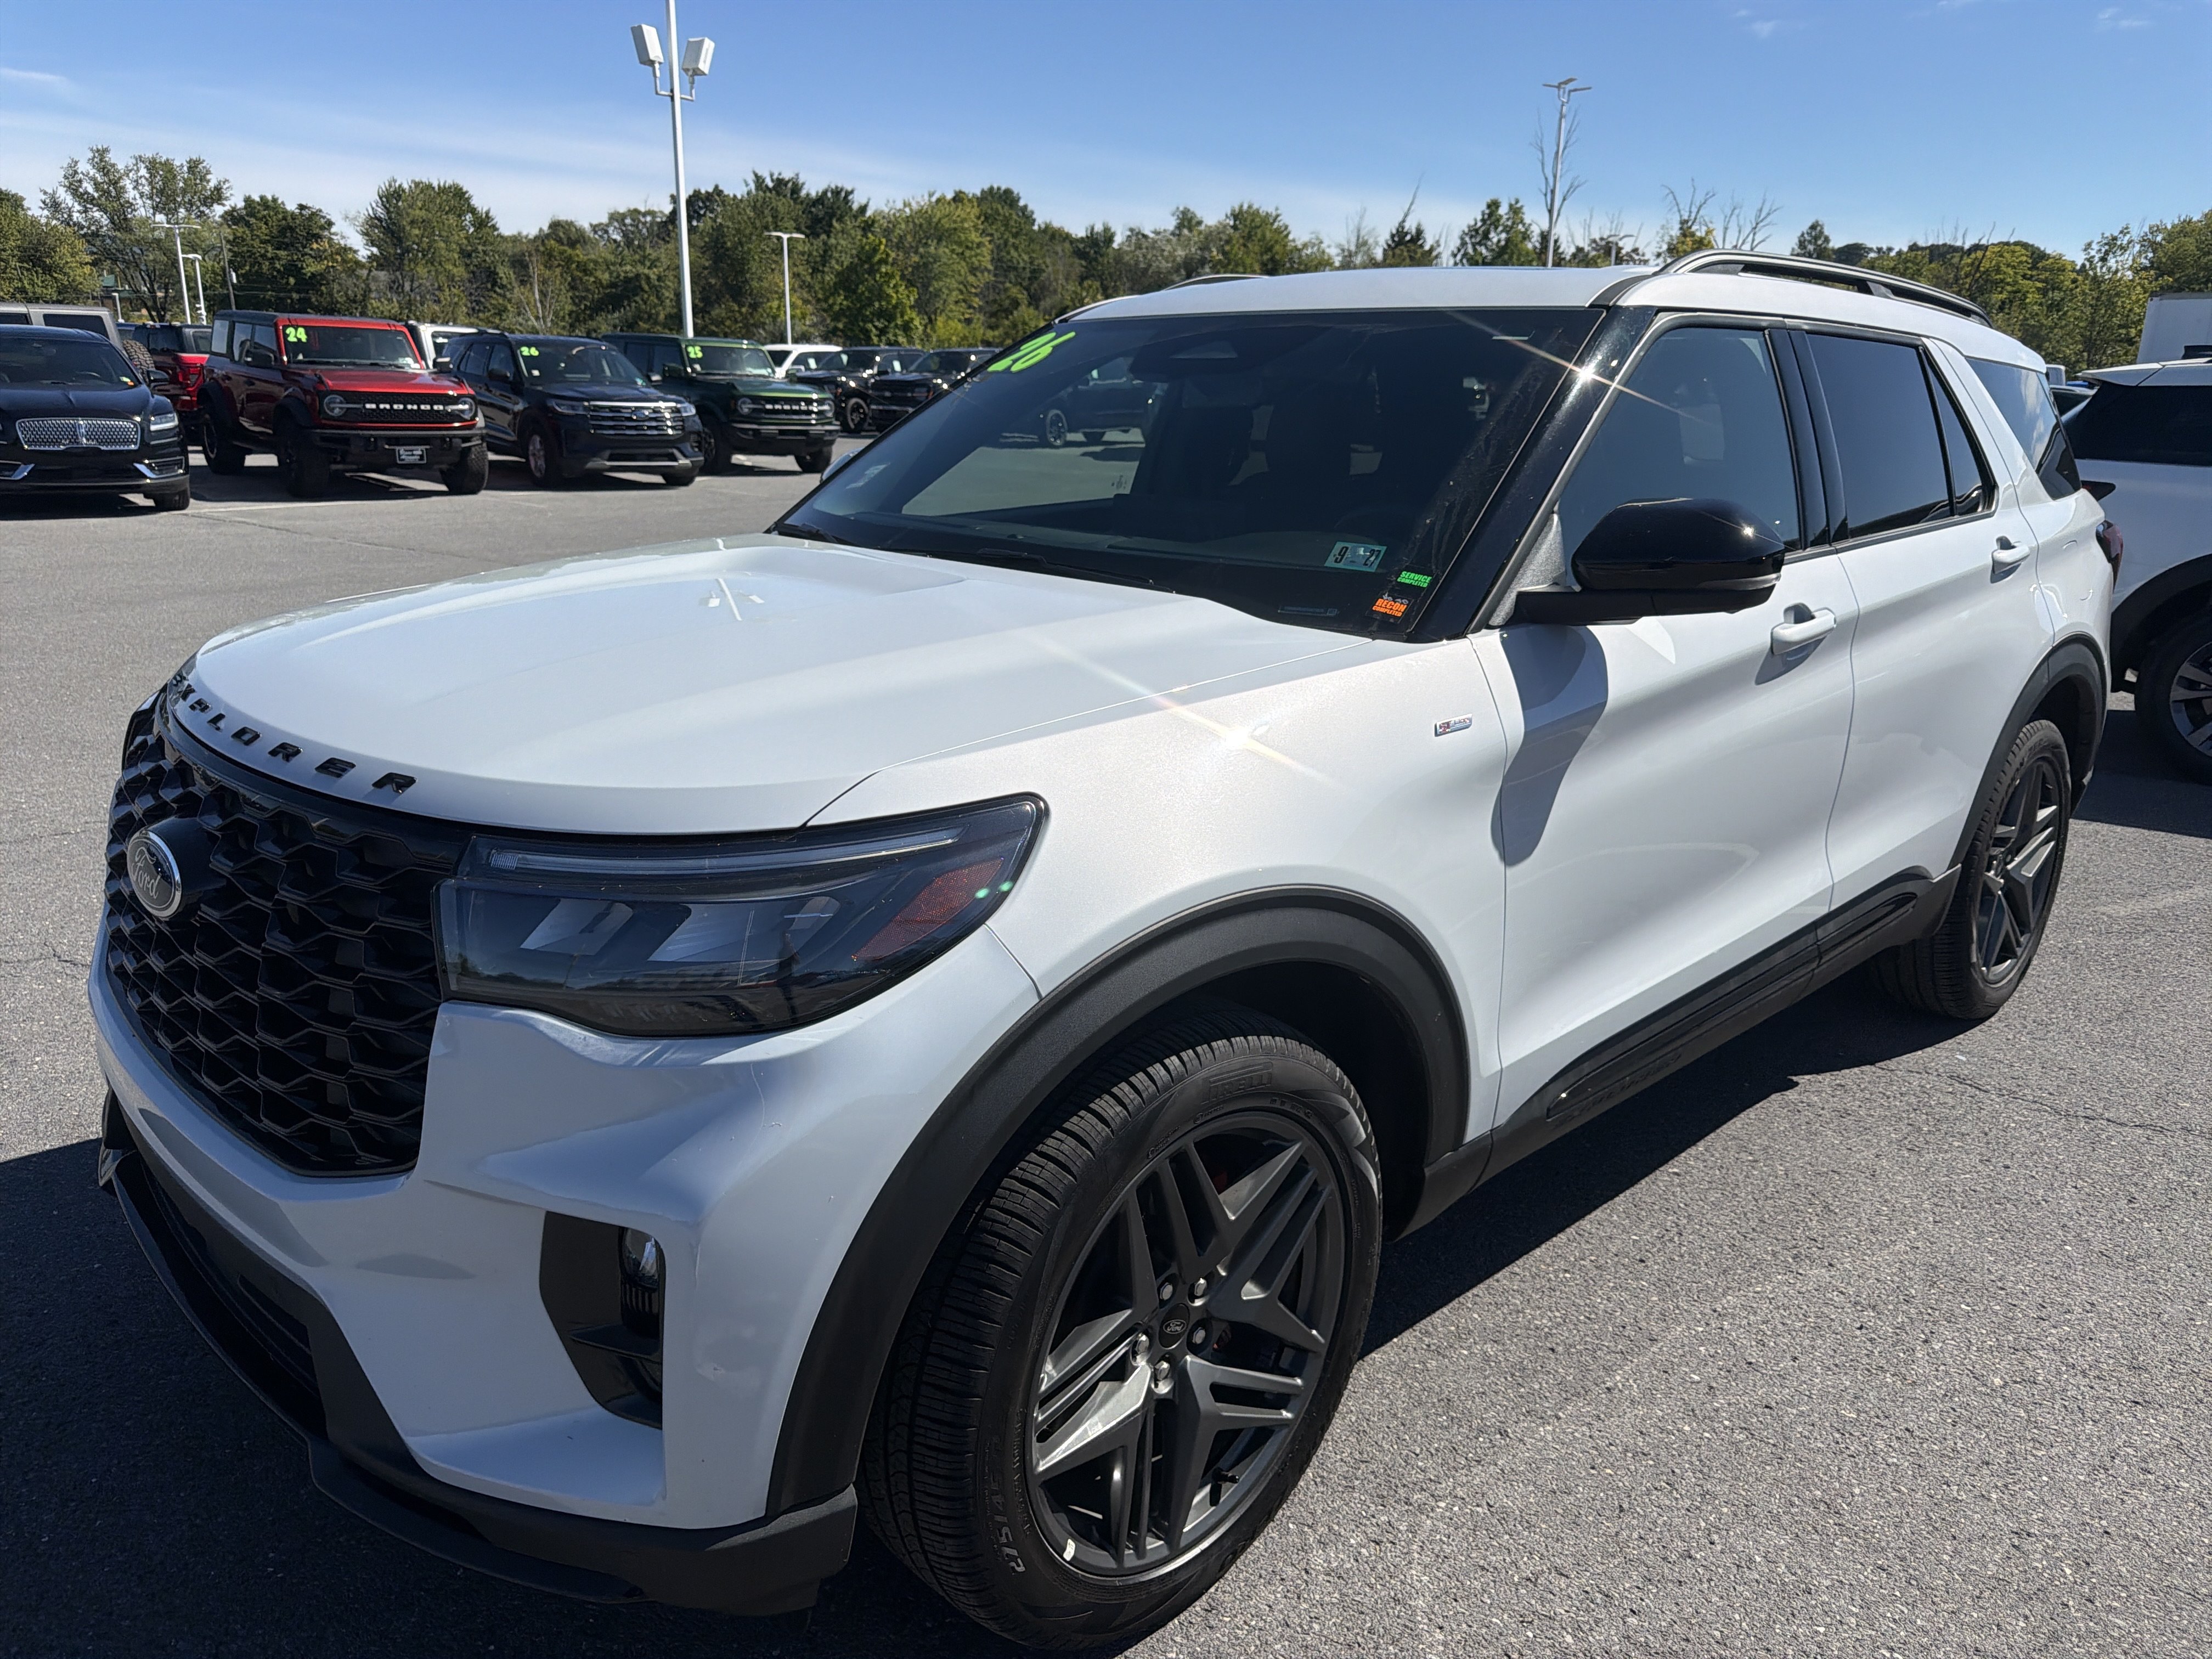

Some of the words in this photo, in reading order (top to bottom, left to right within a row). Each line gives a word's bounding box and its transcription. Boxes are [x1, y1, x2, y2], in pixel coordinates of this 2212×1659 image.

[286, 327, 307, 342] 24
[520, 346, 539, 356] 26
[687, 346, 703, 358] 25
[987, 331, 1076, 373] 26
[1334, 546, 1349, 563] 9
[1363, 549, 1381, 566] 27
[1397, 577, 1427, 587] COMPLETED
[1400, 571, 1432, 583] SERVICE
[1372, 606, 1402, 617] COMPLETED
[1375, 599, 1407, 612] RECON
[172, 670, 417, 794] EXPLORER
[131, 847, 162, 900] Ford
[1167, 1322, 1183, 1331] Ford
